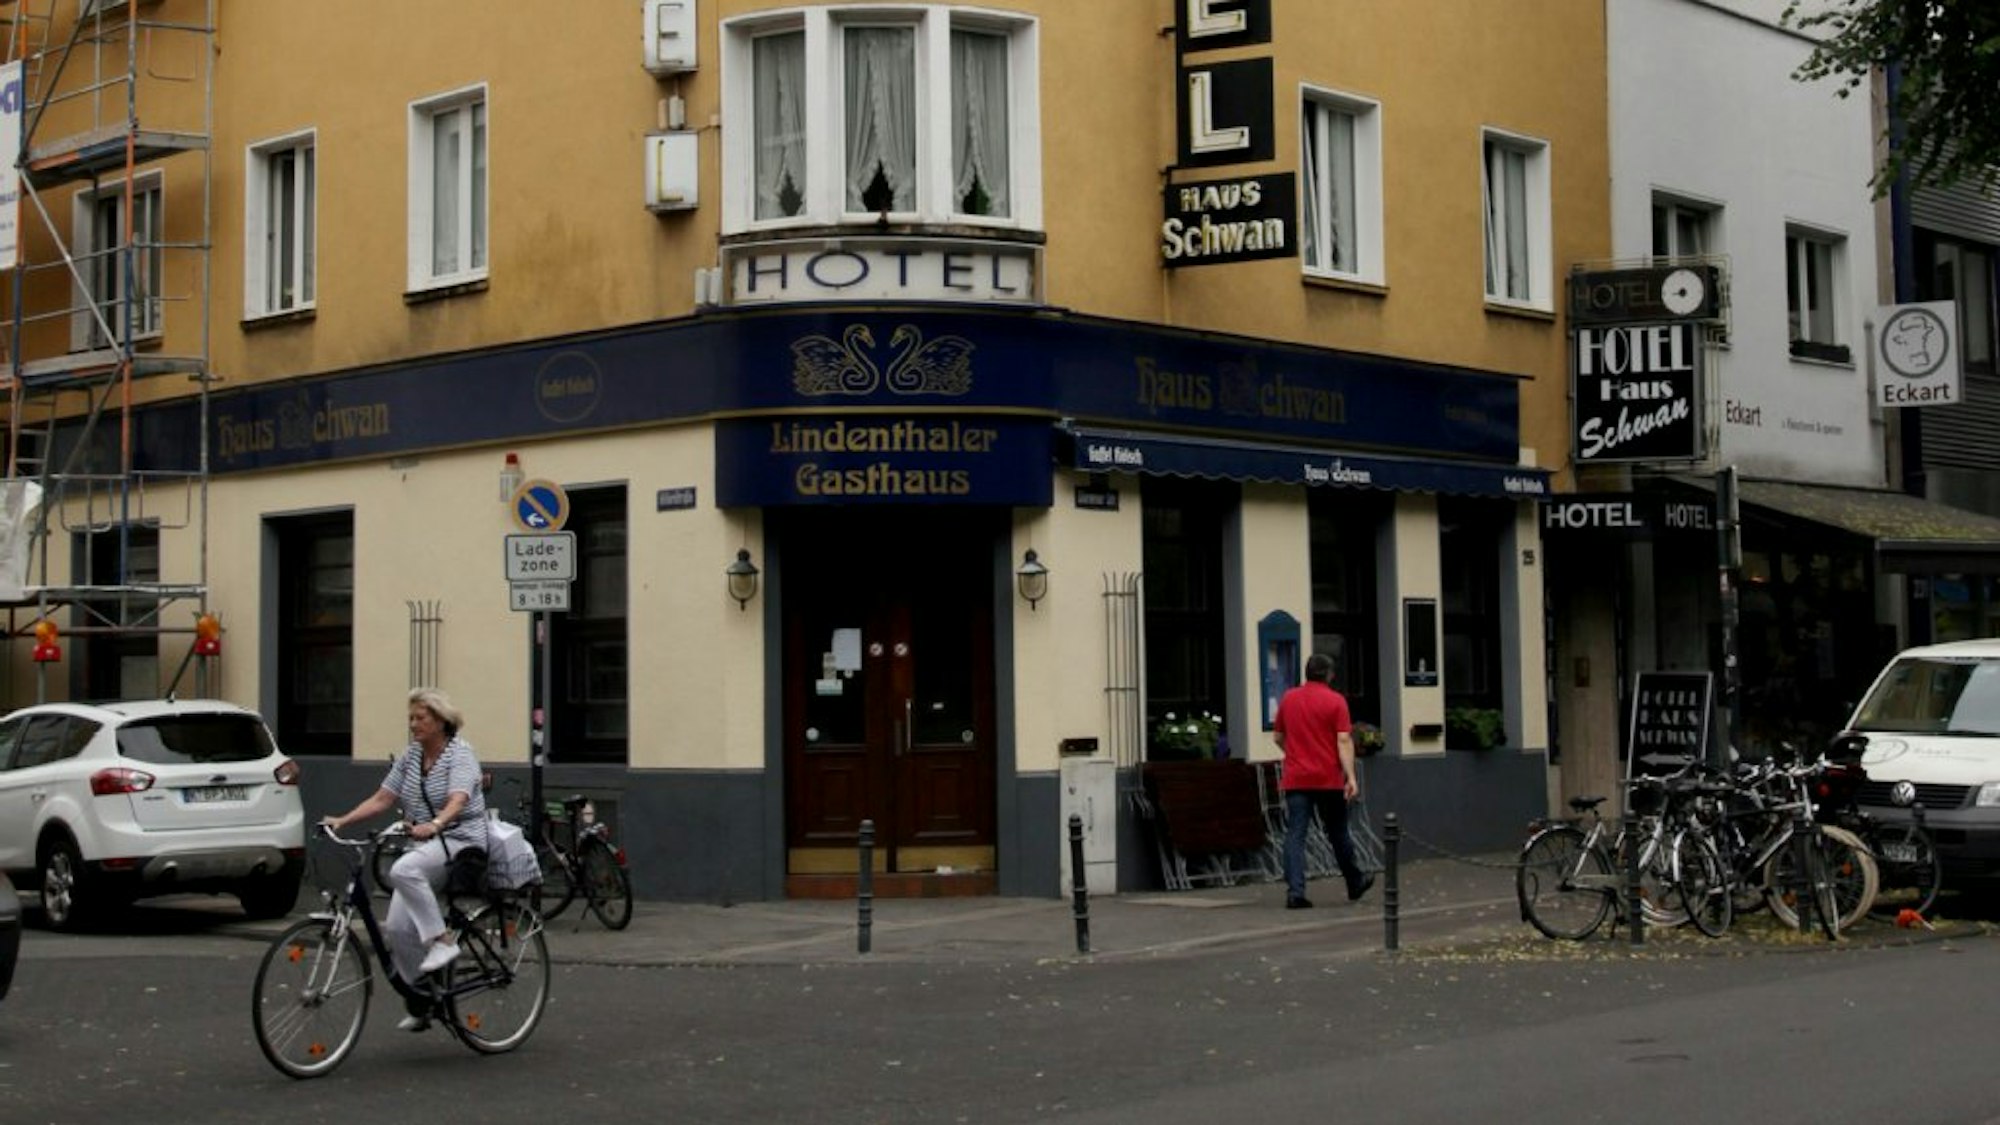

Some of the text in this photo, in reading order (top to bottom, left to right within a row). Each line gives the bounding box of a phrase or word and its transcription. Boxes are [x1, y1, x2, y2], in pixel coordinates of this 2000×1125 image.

[1180, 181, 1262, 212] HAUS
[1162, 214, 1285, 260] Schwan
[748, 250, 1017, 292] HOTEL
[1575, 278, 1661, 313] HOTEL
[1579, 325, 1693, 376] HOTEL
[1601, 379, 1673, 401] Haus
[1884, 382, 1950, 403] Eckart
[1580, 398, 1689, 459] Schwan
[1726, 399, 1761, 427] Eckart
[770, 421, 998, 454] Lindenthaler
[796, 463, 970, 496] Gasthaus
[1546, 503, 1713, 530] HOTEL HOTEL
[515, 541, 563, 557] Lade-
[521, 560, 559, 572] zone
[518, 594, 526, 606] 8
